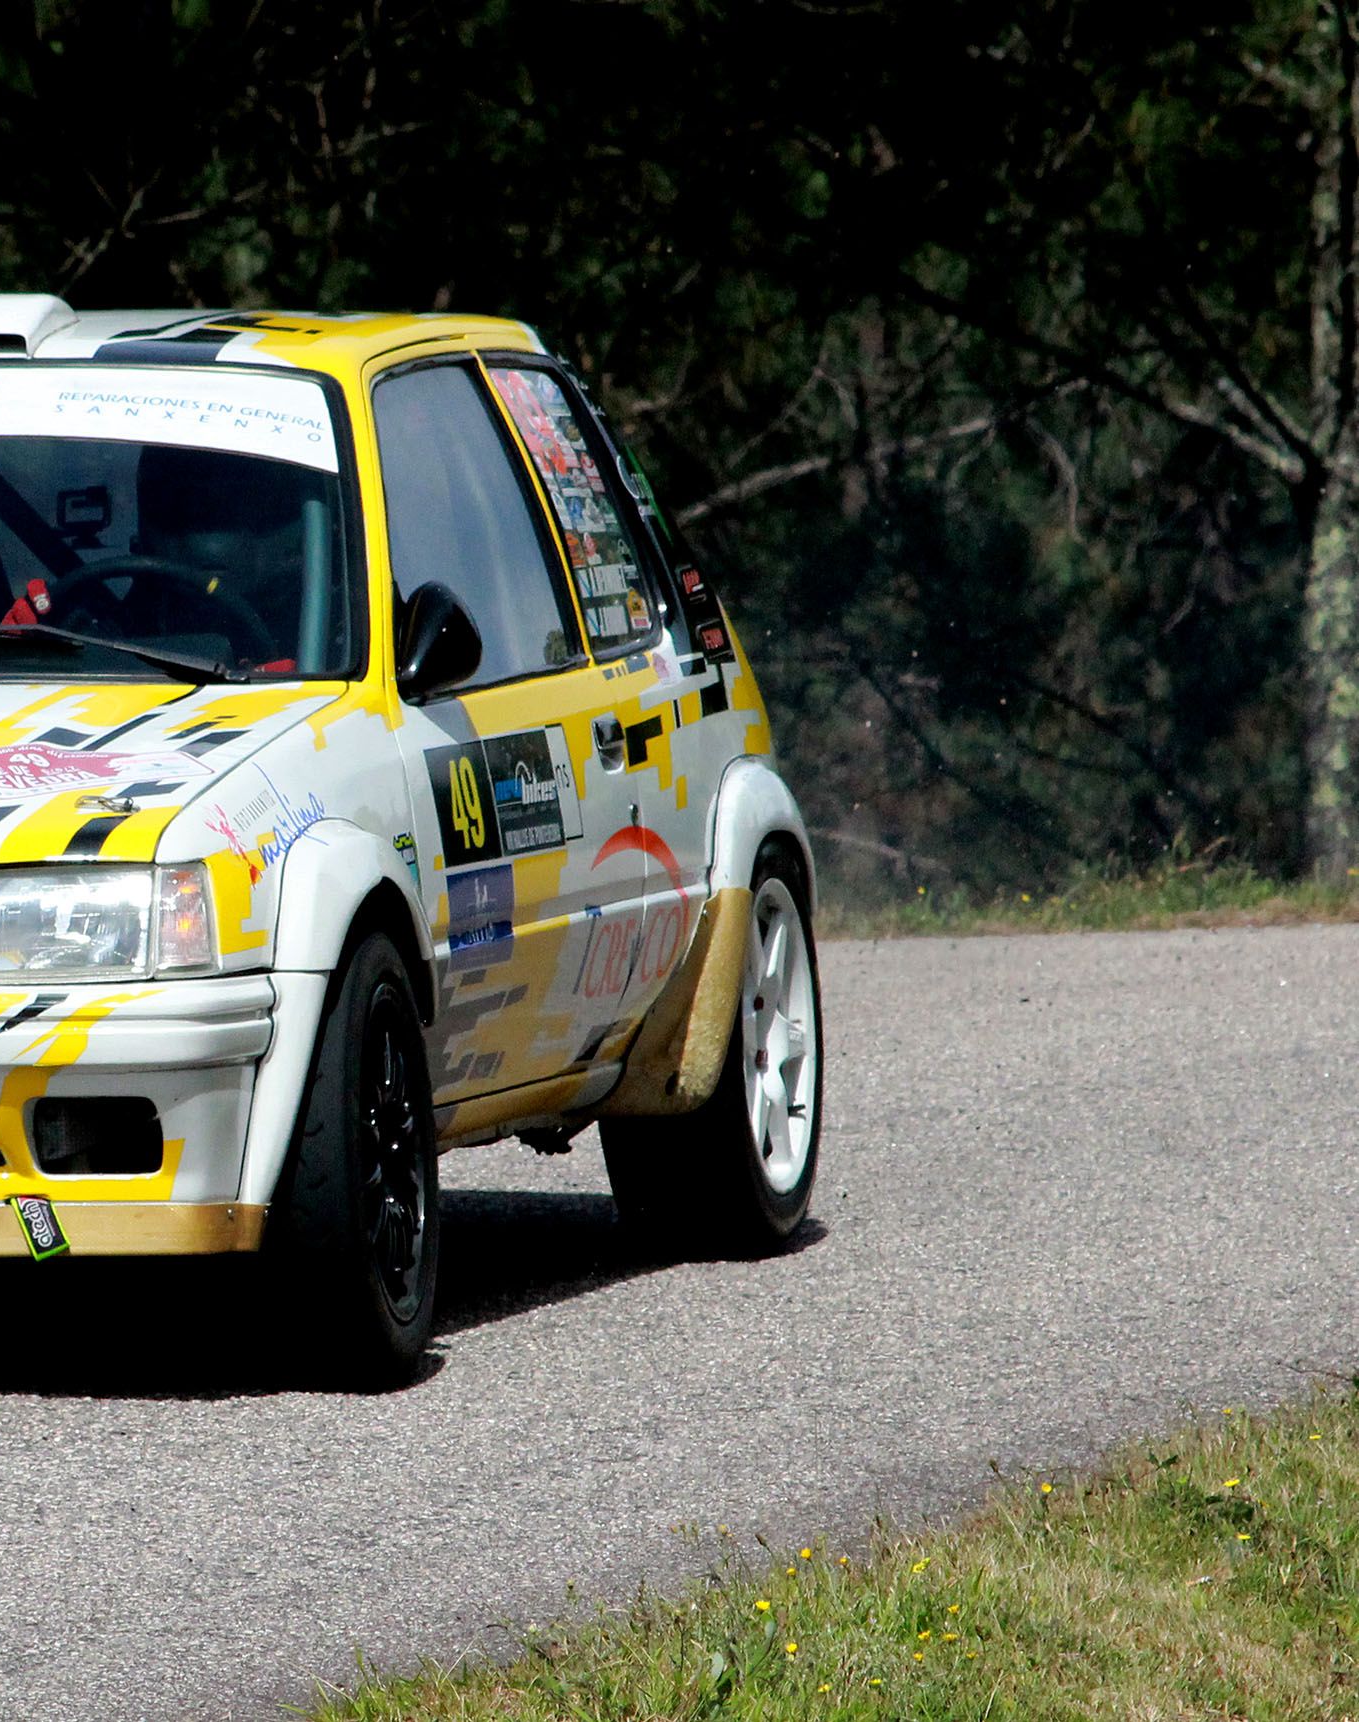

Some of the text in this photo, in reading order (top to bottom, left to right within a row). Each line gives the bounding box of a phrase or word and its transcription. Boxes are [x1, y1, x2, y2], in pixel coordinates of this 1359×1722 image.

[58, 391, 326, 430] REPARACIONES EN GENERAL
[7, 764, 35, 777] DE
[10, 754, 50, 768] 49
[449, 756, 485, 849] 49
